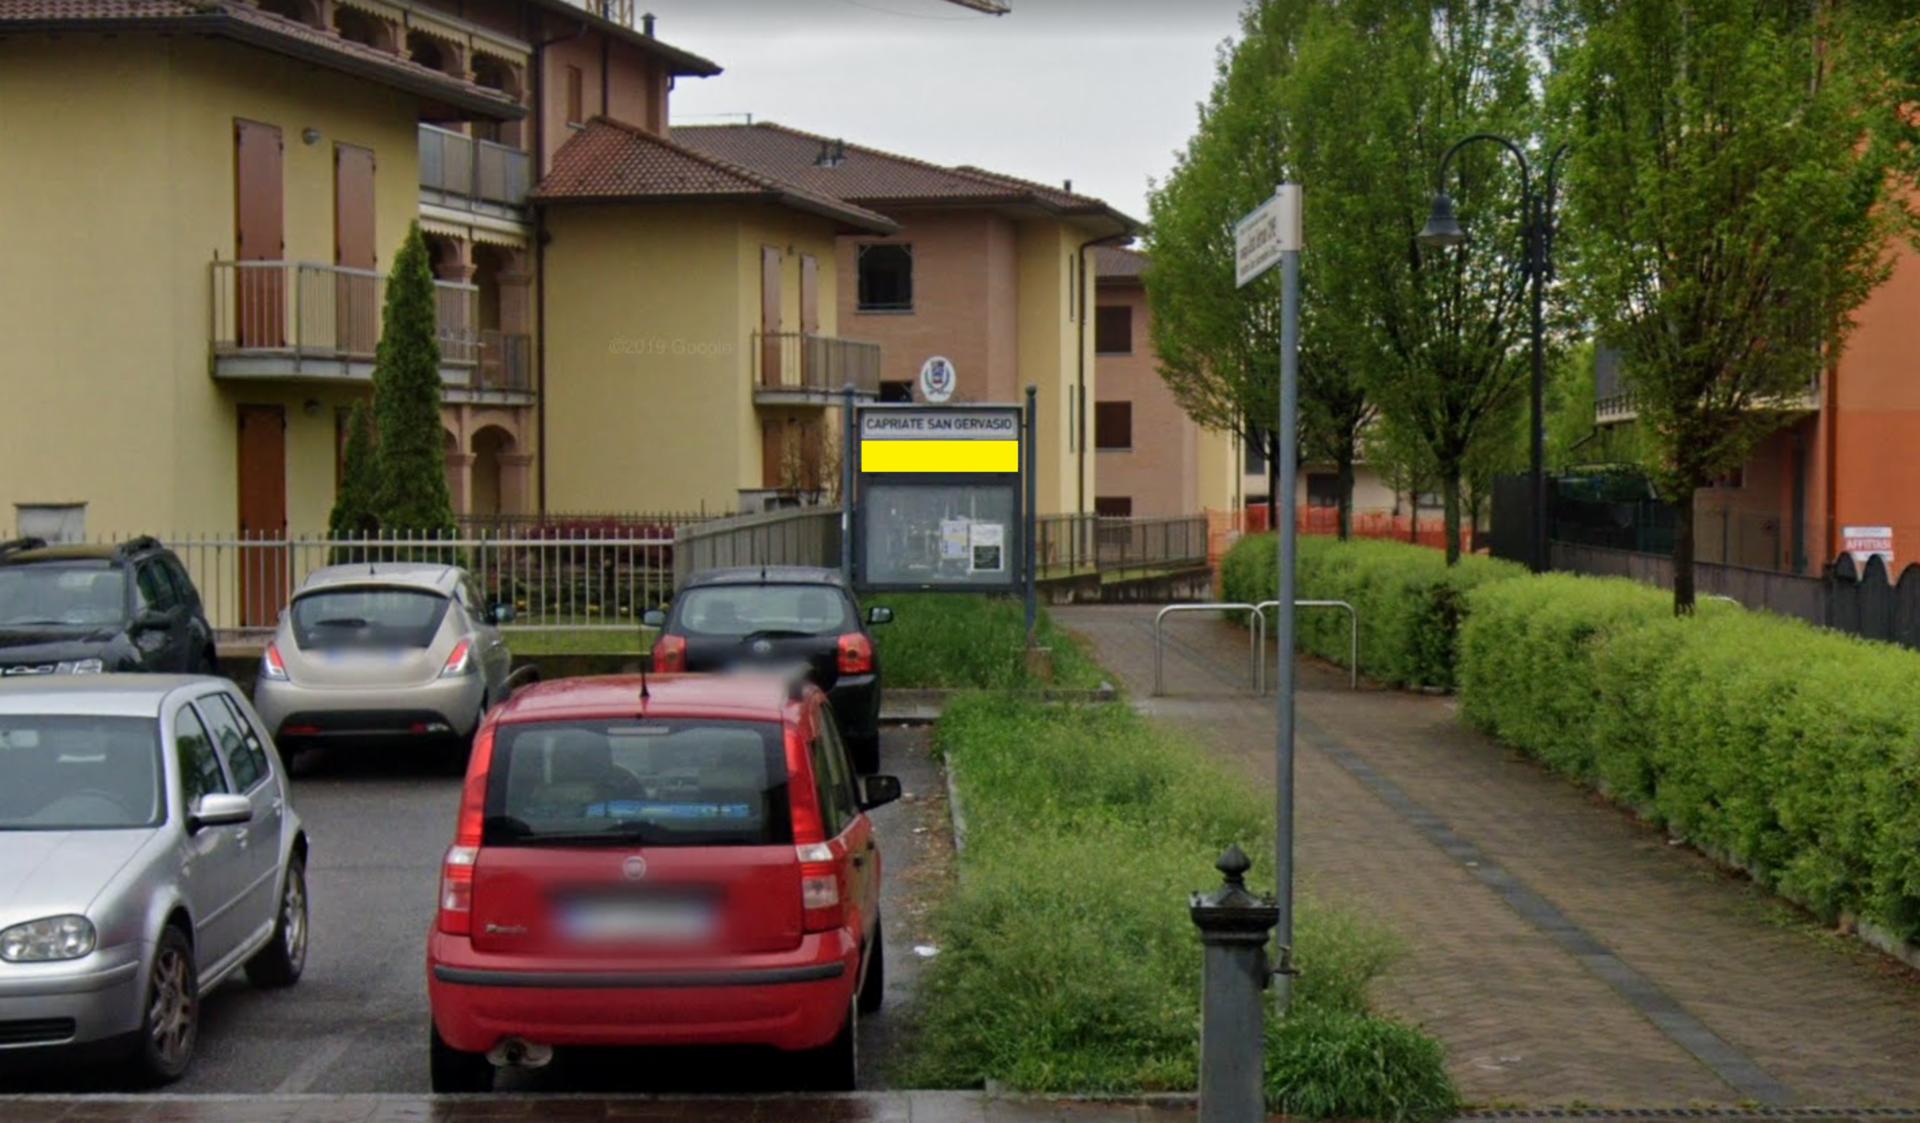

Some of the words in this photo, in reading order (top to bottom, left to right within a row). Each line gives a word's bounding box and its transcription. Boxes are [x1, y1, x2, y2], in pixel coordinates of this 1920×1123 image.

[866, 418, 925, 431] CAPRIATE
[928, 418, 952, 431] SAN
[954, 418, 1013, 431] GERVASIO
